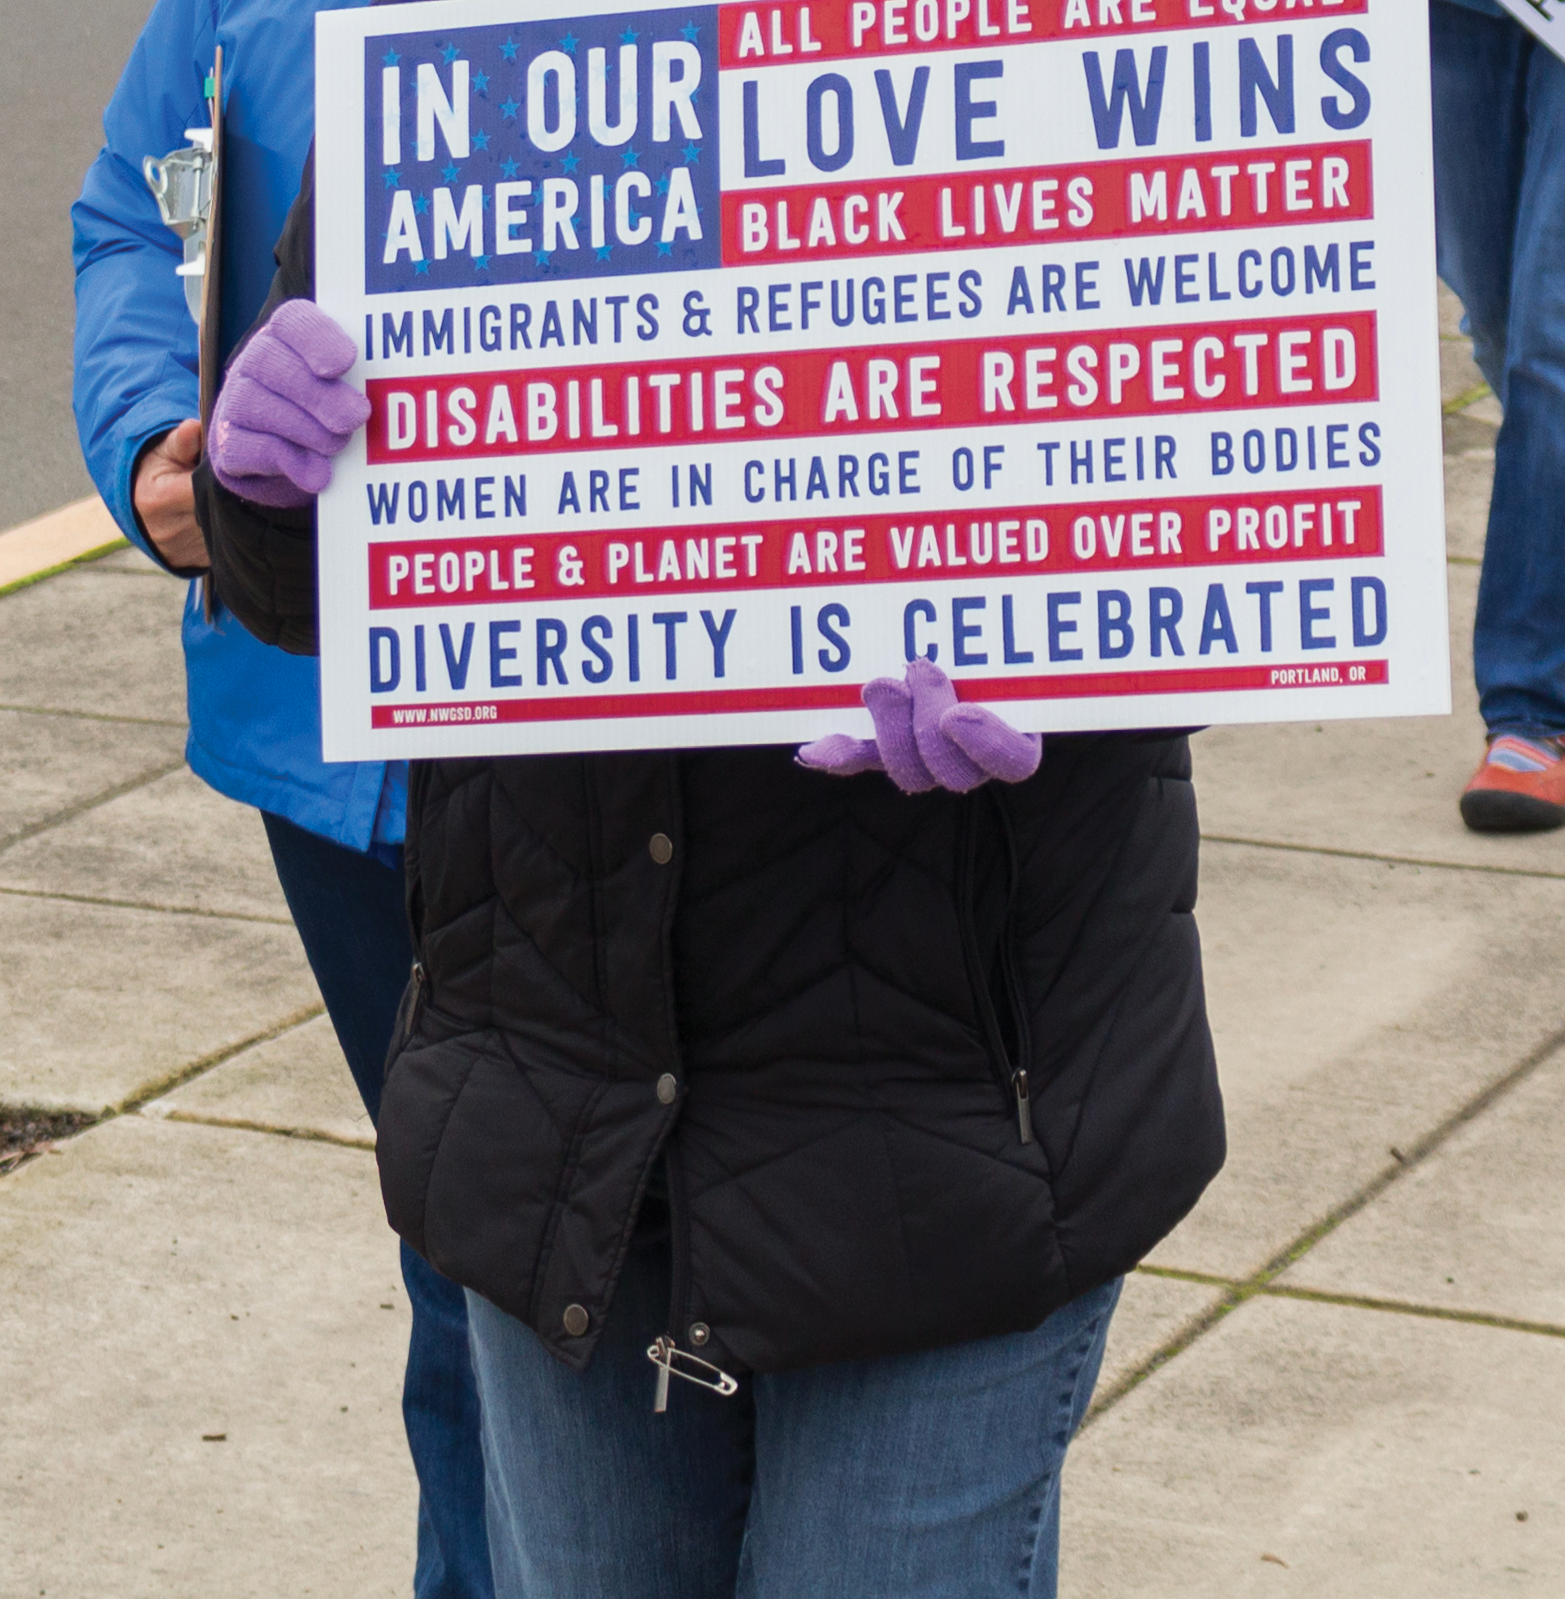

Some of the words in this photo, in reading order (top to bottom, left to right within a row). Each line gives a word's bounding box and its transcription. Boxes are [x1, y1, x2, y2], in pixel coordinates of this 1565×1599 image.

[739, 5, 822, 58] ALL
[383, 60, 471, 165] IN
[527, 40, 703, 152] OUR
[742, 59, 1005, 178] LOVE
[1082, 28, 1371, 149] WINS
[383, 167, 703, 264] AMERICA
[742, 192, 906, 253] BLACK
[942, 176, 1094, 237] LIVES
[1130, 157, 1350, 222] MATTER
[365, 294, 660, 361] IMMIGRANTS
[683, 290, 713, 337] &
[738, 269, 982, 333] REFUGEES
[1007, 260, 1100, 315] ARE
[1125, 241, 1376, 306] WELCOME
[386, 366, 785, 451] DISABILITIES
[824, 355, 942, 423] ARE
[983, 328, 1356, 413] RESPECTED
[367, 474, 527, 525] WOMEN
[558, 467, 640, 514] ARE
[671, 463, 713, 508] IN
[744, 450, 921, 503] CHARGE
[952, 445, 1005, 491] OF
[1038, 435, 1177, 486] THEIR
[1211, 421, 1381, 476] BODIES
[389, 548, 534, 595] PEOPLE
[558, 544, 585, 586] &
[608, 535, 763, 585] PLANET
[788, 530, 866, 575] ARE
[890, 519, 1049, 569] VALUED
[1073, 512, 1182, 560] OVER
[1209, 501, 1362, 552] PROFIT
[369, 608, 737, 694] DIVERSITY
[790, 602, 851, 675] IS
[903, 576, 1388, 668] CELEBRATED
[1271, 667, 1343, 685] PORTLAND,
[1349, 665, 1366, 681] OR
[393, 706, 497, 723] WWW.NWGSD.ORG
